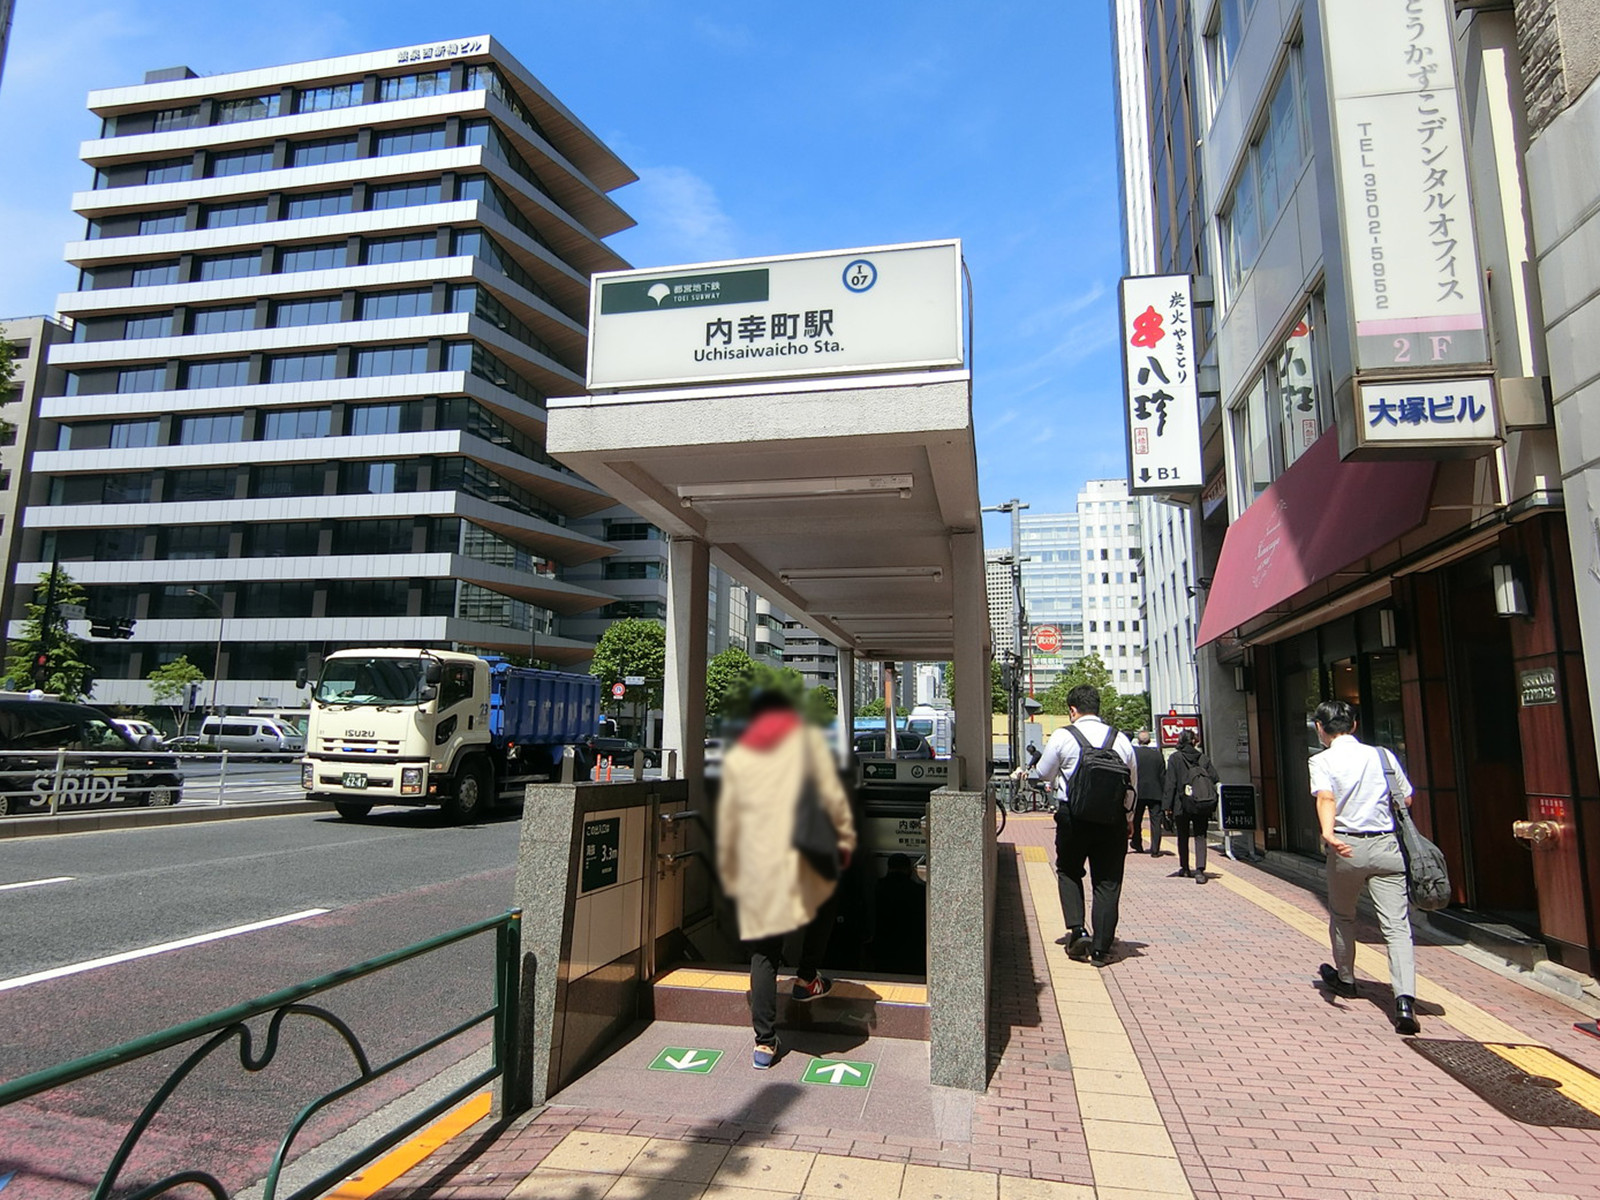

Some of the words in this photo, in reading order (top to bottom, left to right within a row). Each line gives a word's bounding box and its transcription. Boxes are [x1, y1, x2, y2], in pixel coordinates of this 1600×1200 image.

[851, 275, 869, 286] 07
[673, 281, 721, 294] 都営地下鉄
[691, 292, 720, 300] SUBWAY
[705, 309, 834, 346] 内幸町駅
[694, 341, 809, 362] Uchisaiwaicho
[814, 339, 844, 354] Sta.
[1368, 395, 1486, 428] 大塚ビル
[1157, 467, 1181, 480] B1
[344, 729, 375, 738] ISUZU
